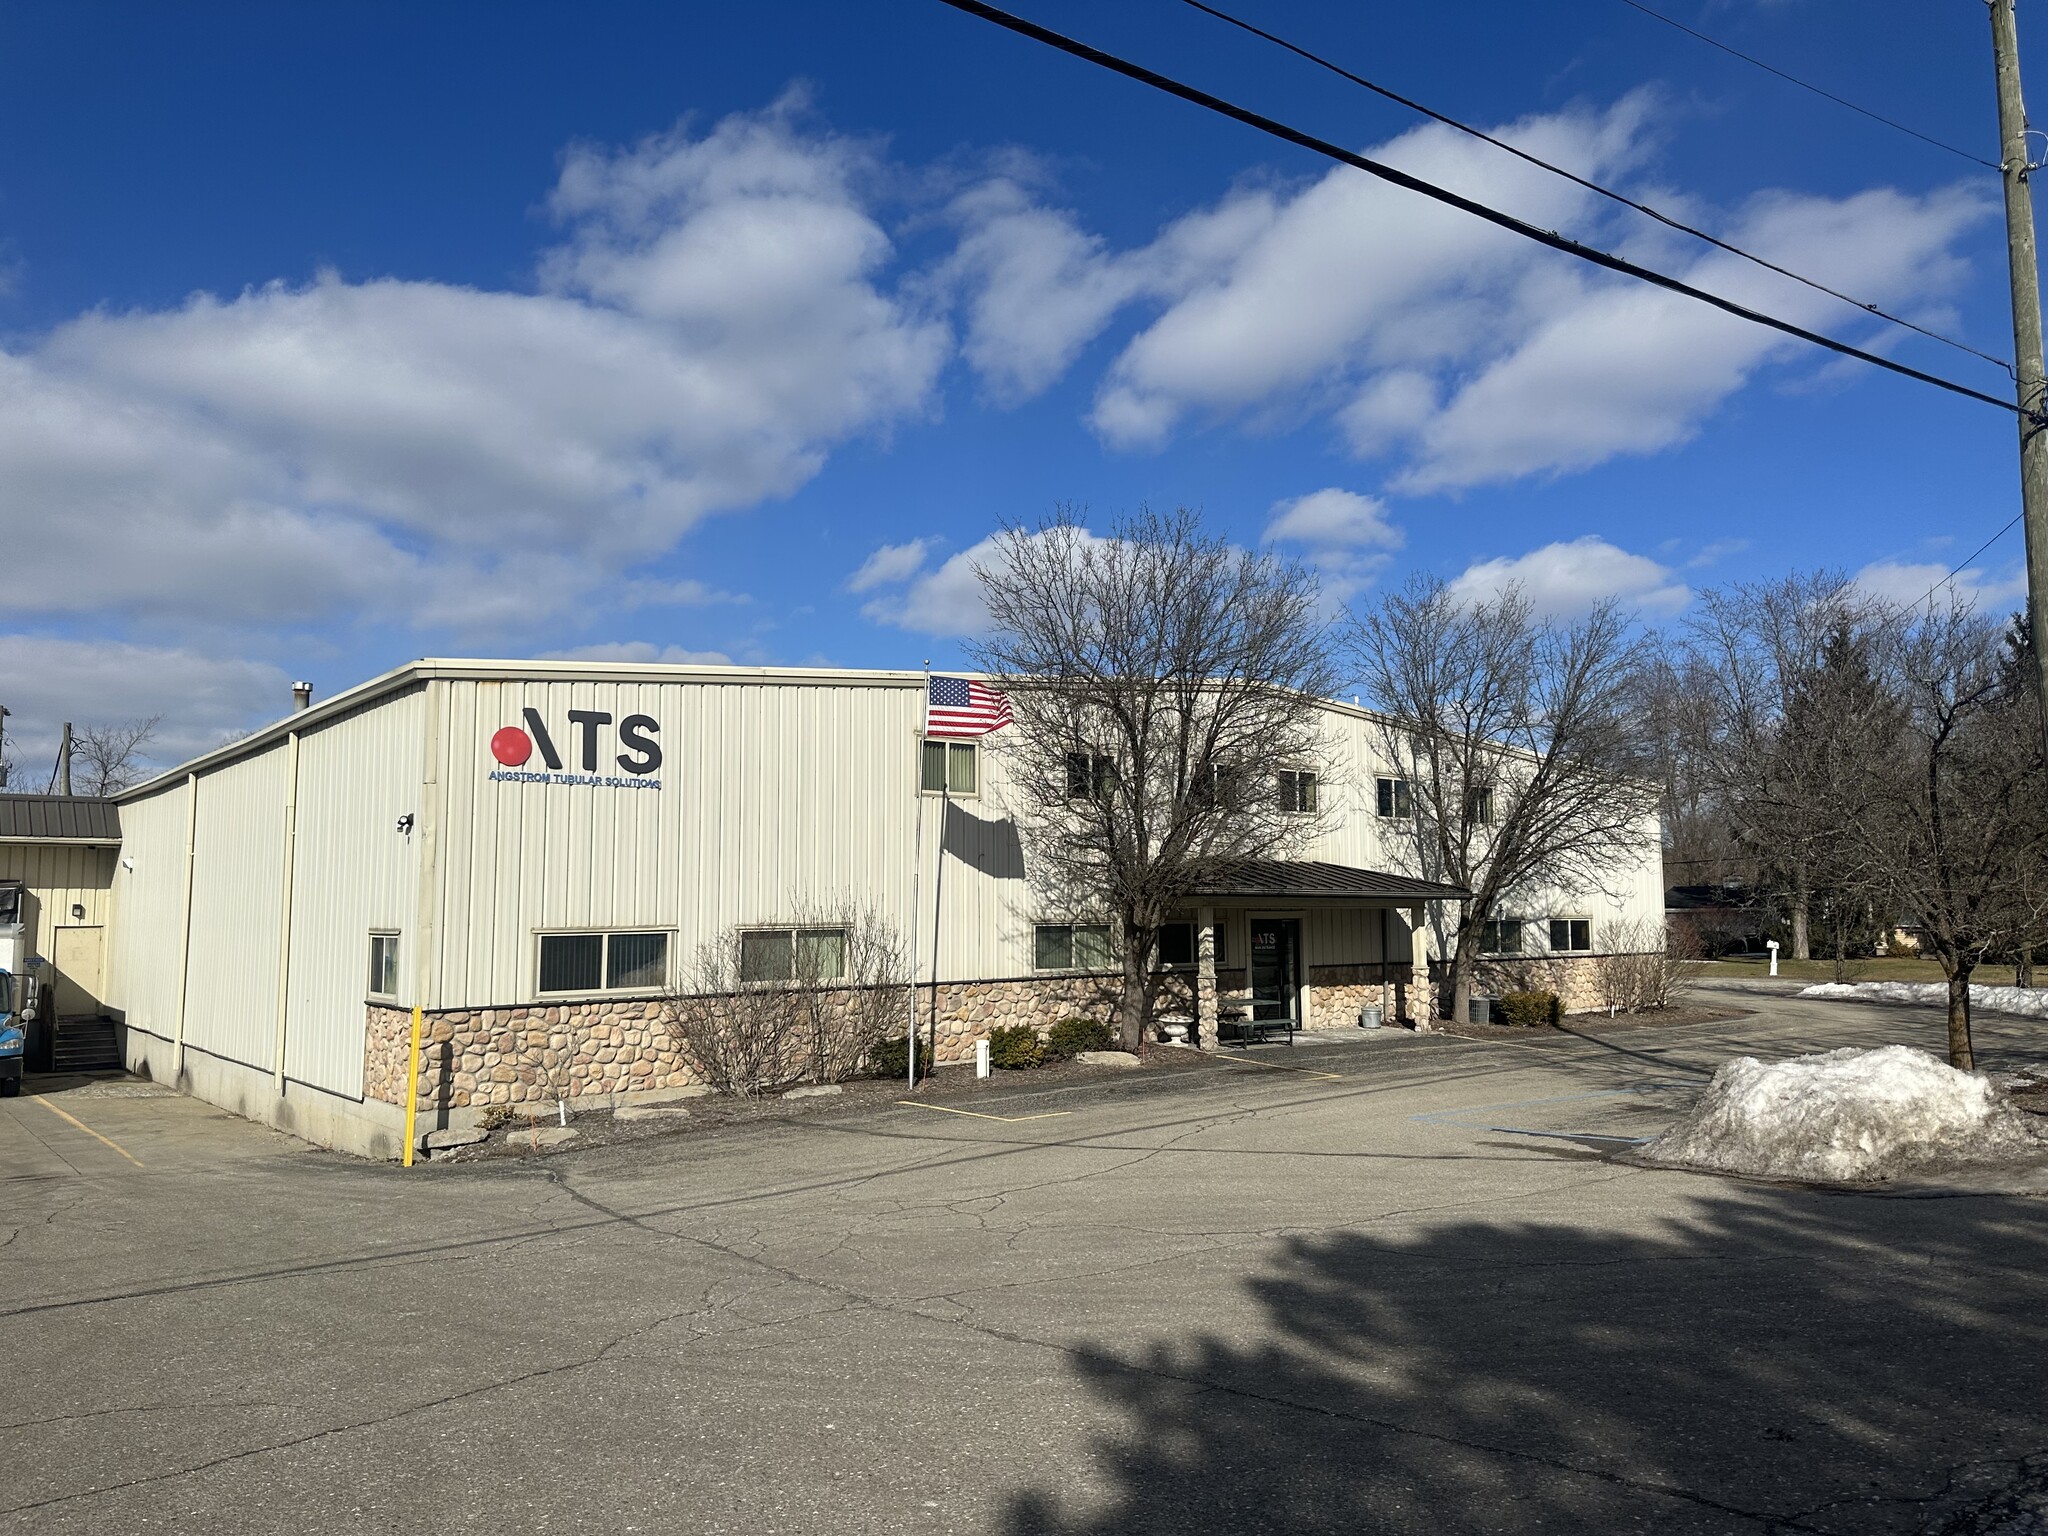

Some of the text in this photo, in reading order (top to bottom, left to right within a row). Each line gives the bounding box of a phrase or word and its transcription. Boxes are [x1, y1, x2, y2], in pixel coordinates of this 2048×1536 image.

[491, 708, 662, 774] ATS
[489, 771, 661, 788] ANGSTROM TUBULAR SOLUTIONS
[1255, 933, 1276, 944] ATS
